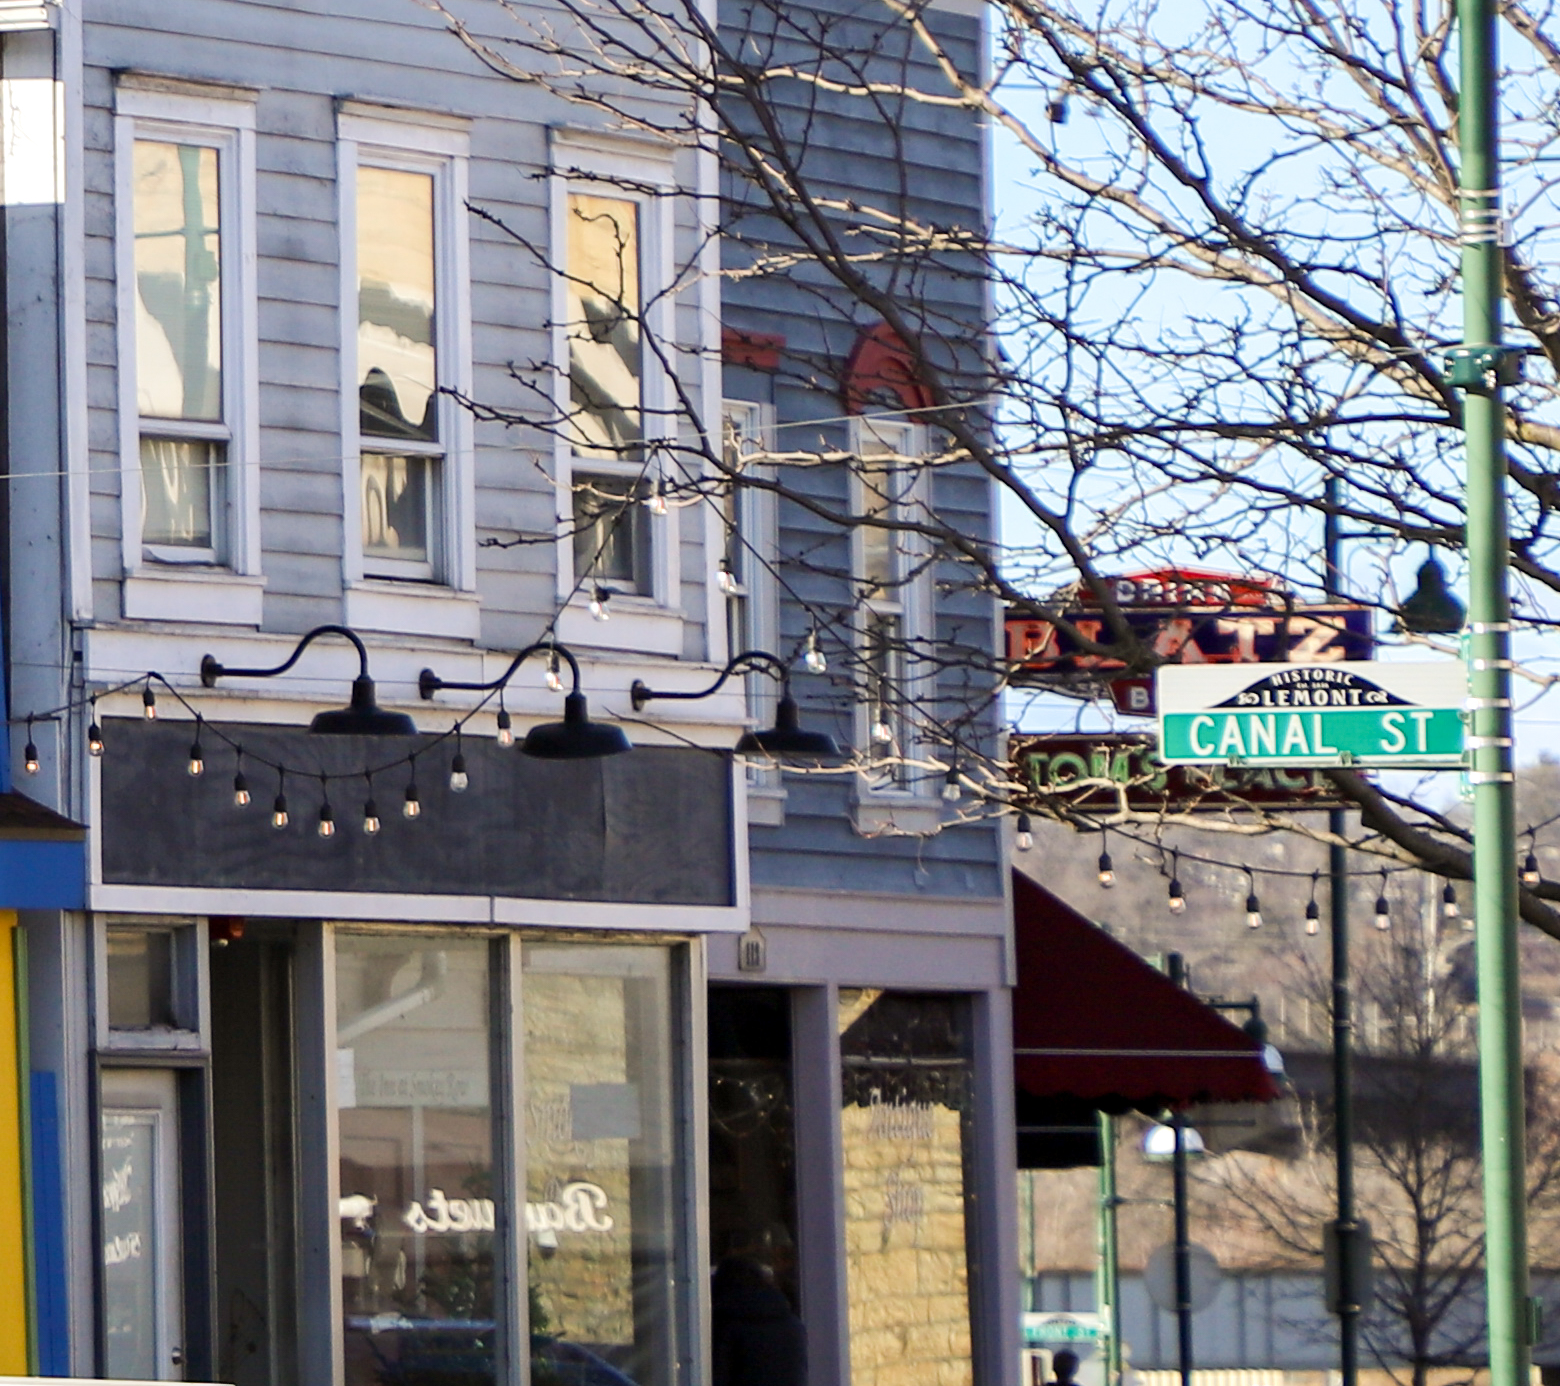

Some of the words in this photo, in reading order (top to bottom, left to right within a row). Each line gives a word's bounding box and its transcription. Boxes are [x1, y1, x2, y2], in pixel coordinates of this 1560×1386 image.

[1271, 669, 1355, 687] HISTORIC
[1263, 688, 1363, 707] LEMONT
[1189, 713, 1338, 757] CANAL
[1380, 711, 1435, 753] ST
